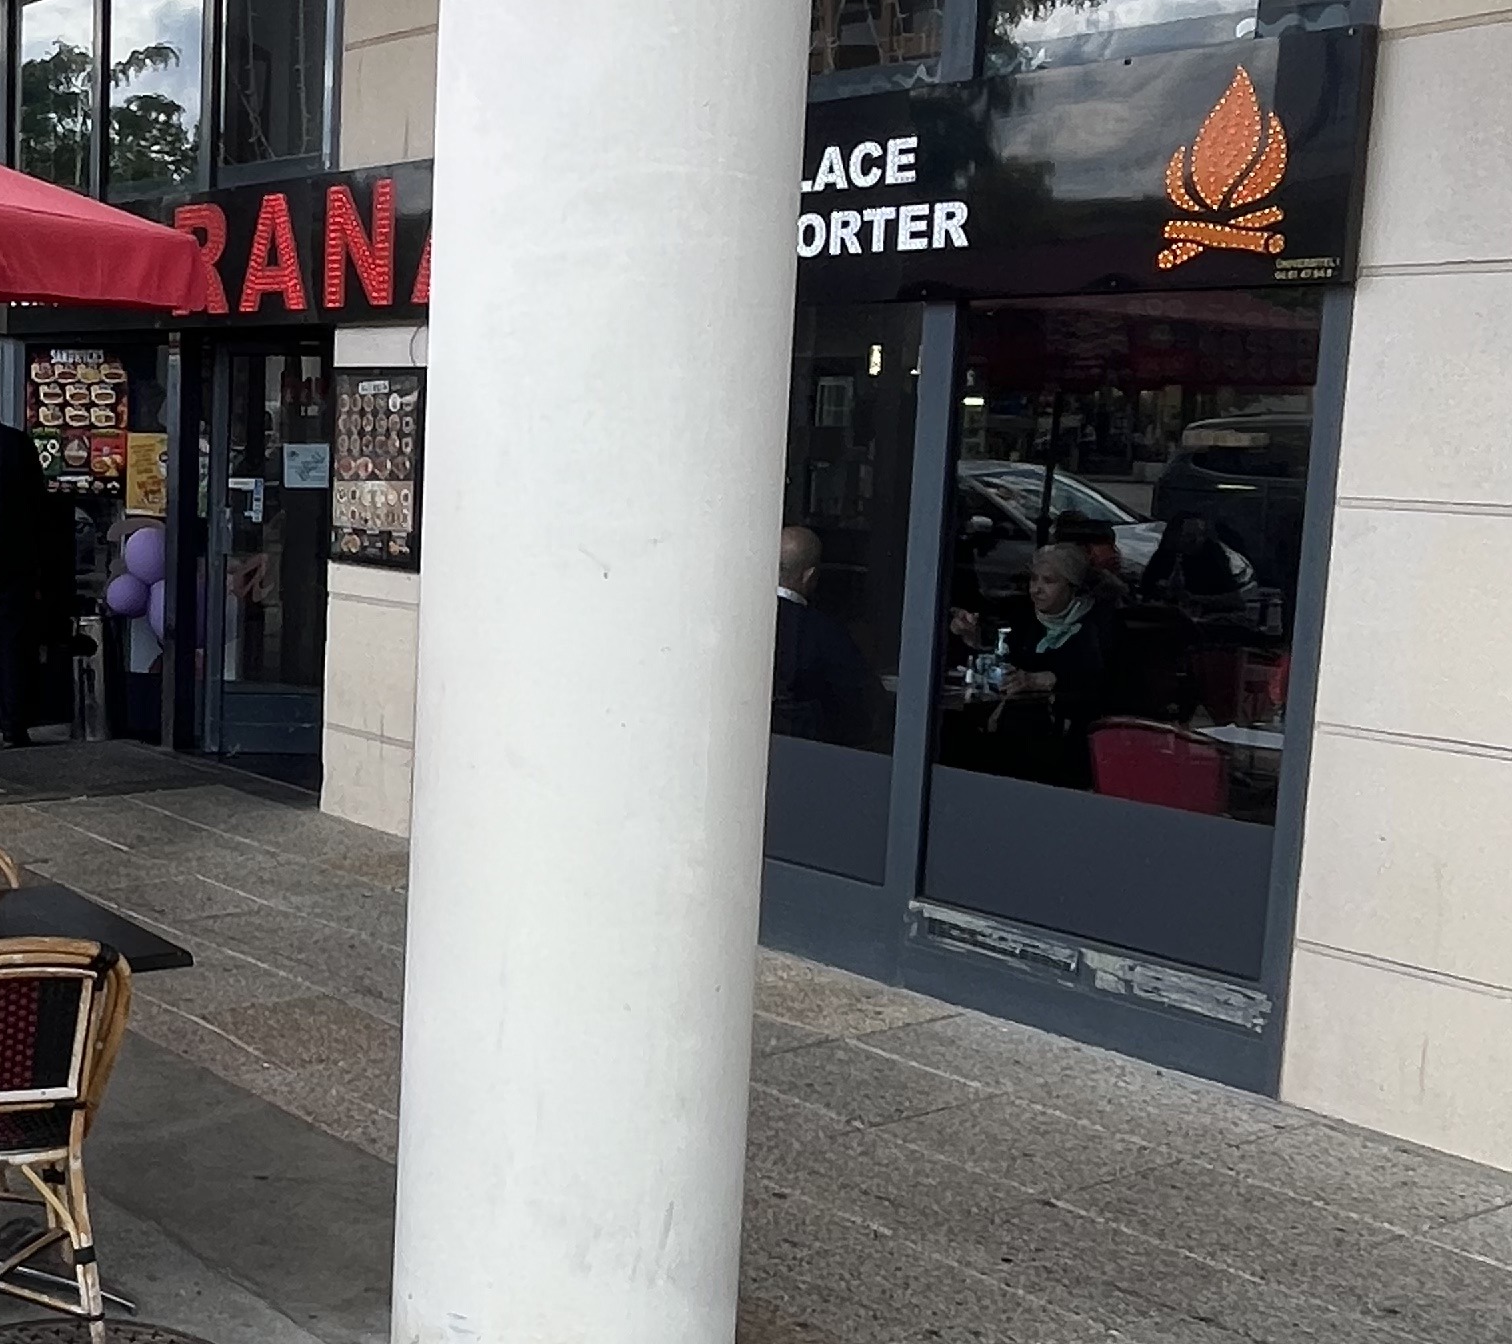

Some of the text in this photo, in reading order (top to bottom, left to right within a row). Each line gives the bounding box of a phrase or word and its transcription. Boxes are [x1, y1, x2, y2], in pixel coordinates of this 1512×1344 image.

[800, 136, 918, 191] ACE
[173, 178, 431, 316] RAN
[797, 201, 969, 257] ORTER
